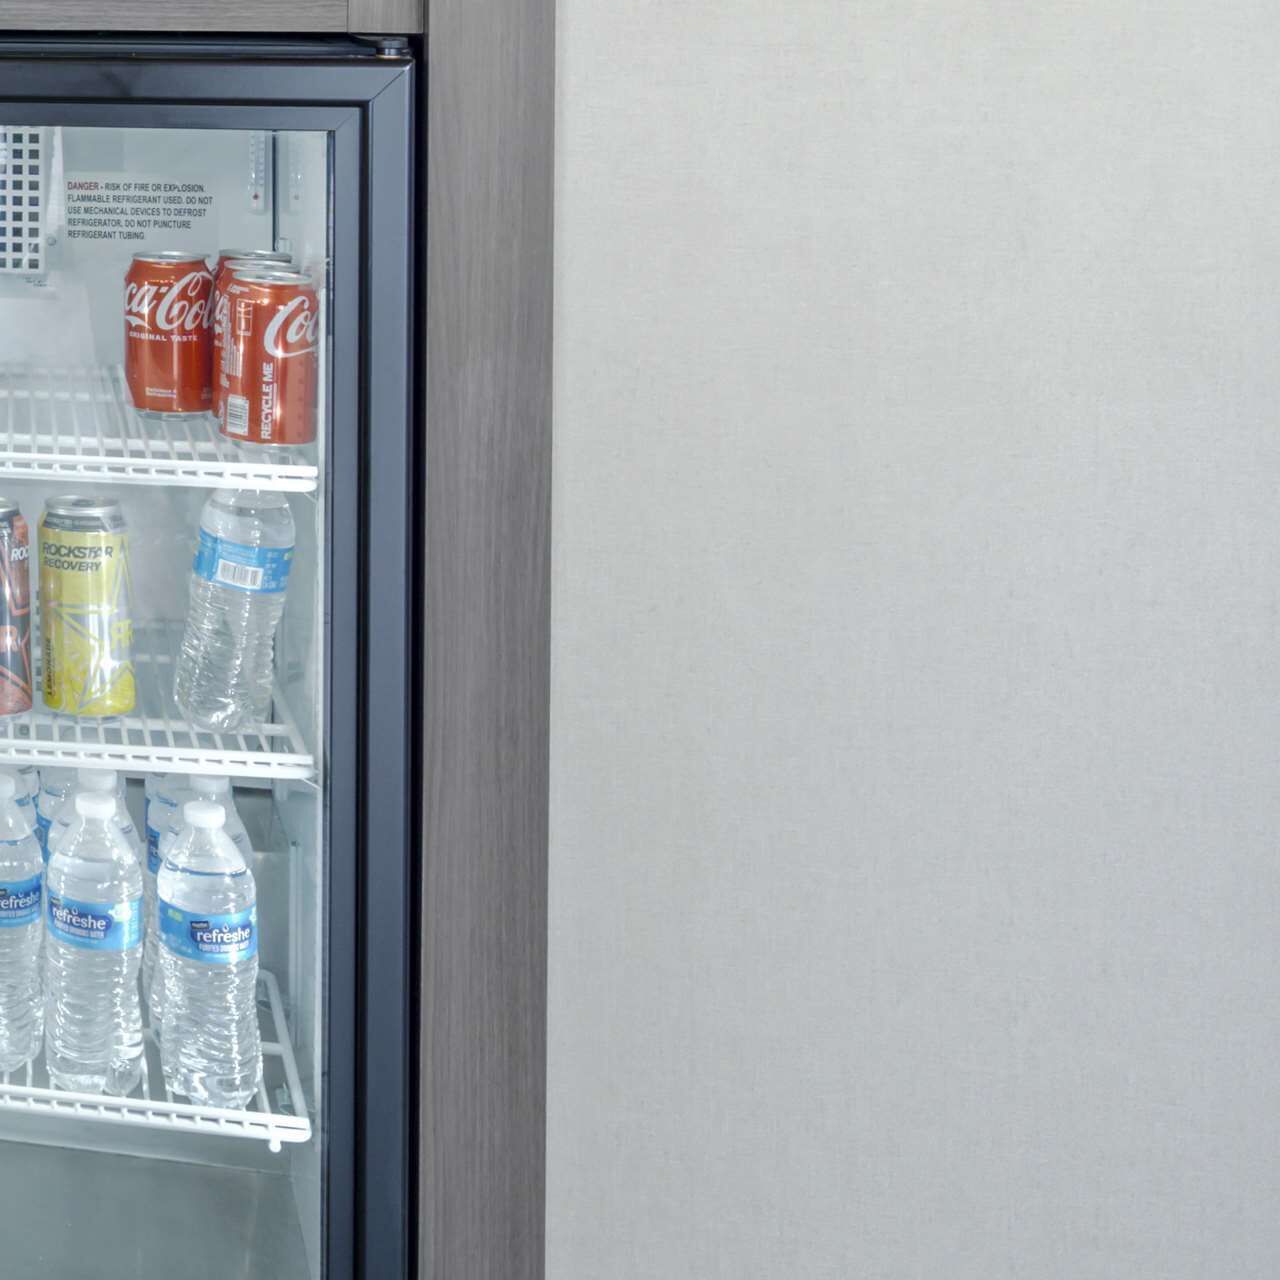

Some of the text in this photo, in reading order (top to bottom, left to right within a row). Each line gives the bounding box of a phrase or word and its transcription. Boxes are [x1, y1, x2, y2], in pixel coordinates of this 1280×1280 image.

[67, 181, 162, 192] DANGER RISK OF FIRE OR
[67, 194, 111, 203] FLAMMABLE
[112, 195, 161, 205] REFRIGERANT
[185, 196, 196, 205] DO
[198, 196, 213, 205] NOT
[67, 207, 207, 217] USE MECHANICAL DEVICES TO DEFROST
[124, 219, 191, 229] DO NOT PUNCTURE
[67, 230, 117, 239] REFRIGERANT
[129, 331, 198, 342] ORIGINAL TASTE
[261, 362, 273, 440] RECYCLE ME
[42, 542, 113, 558] ROCKSTAR
[43, 559, 102, 572] RECOVERY
[52, 907, 107, 930] refreshe
[197, 928, 250, 944] refreshe
